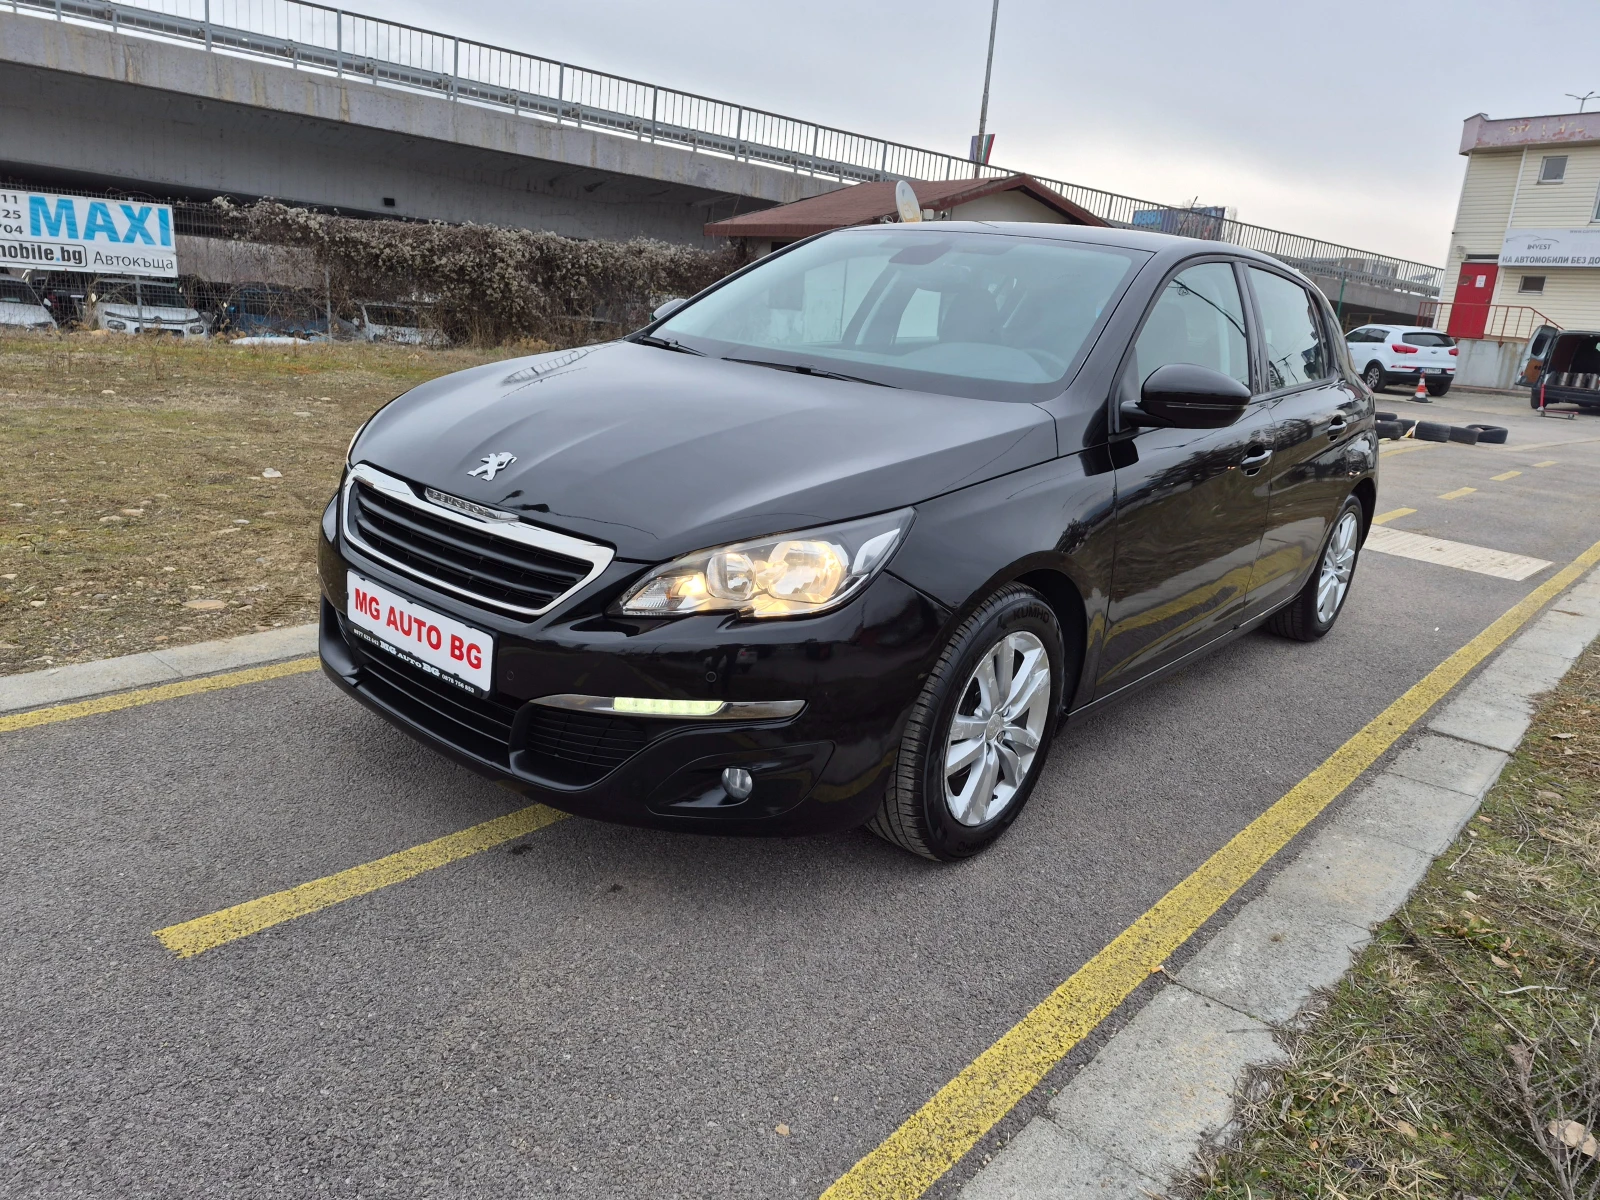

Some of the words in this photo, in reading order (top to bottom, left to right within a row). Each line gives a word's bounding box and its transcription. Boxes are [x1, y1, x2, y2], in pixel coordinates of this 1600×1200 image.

[2, 209, 22, 220] 25
[28, 196, 172, 246] MAXI
[0, 224, 24, 235] 04
[94, 250, 174, 271] Автокъща
[1514, 256, 1569, 264] АВТОМОБИЛИ
[1570, 256, 1587, 264] БЕЗ
[1588, 256, 1600, 265] ДО
[432, 491, 489, 516] PEUGEOT
[1013, 606, 1050, 624] KUMHO
[355, 587, 381, 621] MG
[386, 606, 442, 651] AUTO
[450, 633, 482, 670] BG
[397, 652, 422, 668] AUTO
